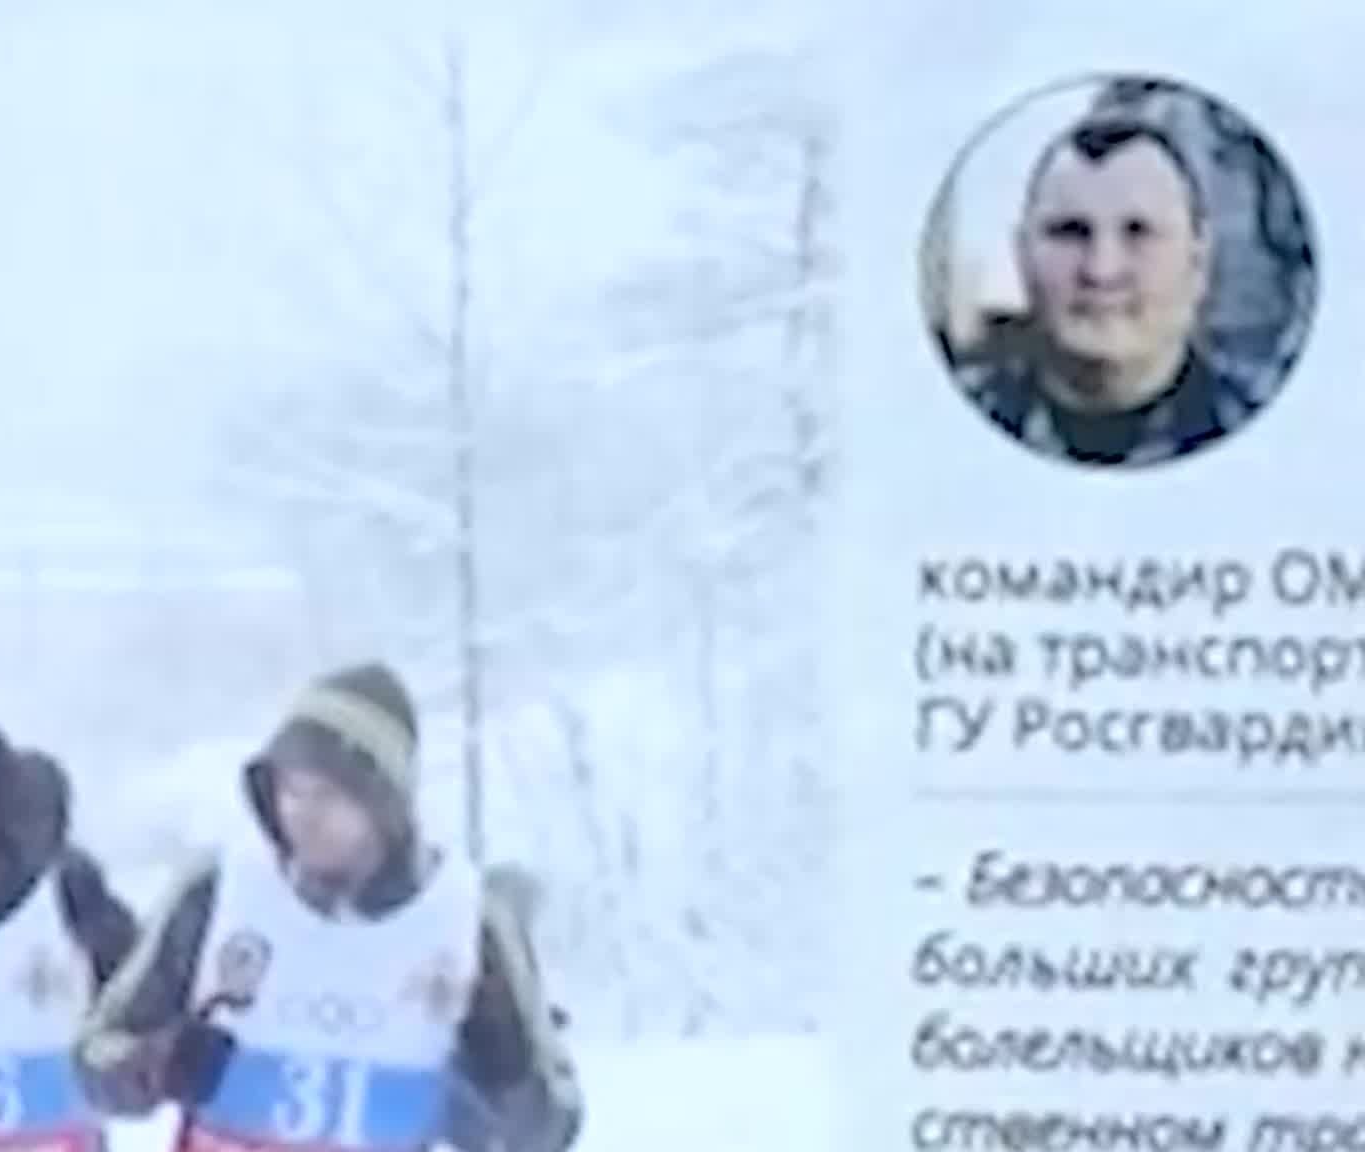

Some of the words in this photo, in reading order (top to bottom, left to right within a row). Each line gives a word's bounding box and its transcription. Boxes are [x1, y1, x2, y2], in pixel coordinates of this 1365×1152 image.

[919, 558, 1254, 620] командир
[914, 624, 1018, 682] (на
[917, 698, 996, 753] ГУ
[911, 928, 1197, 992] больших
[911, 1011, 1324, 1077] болельщиков
